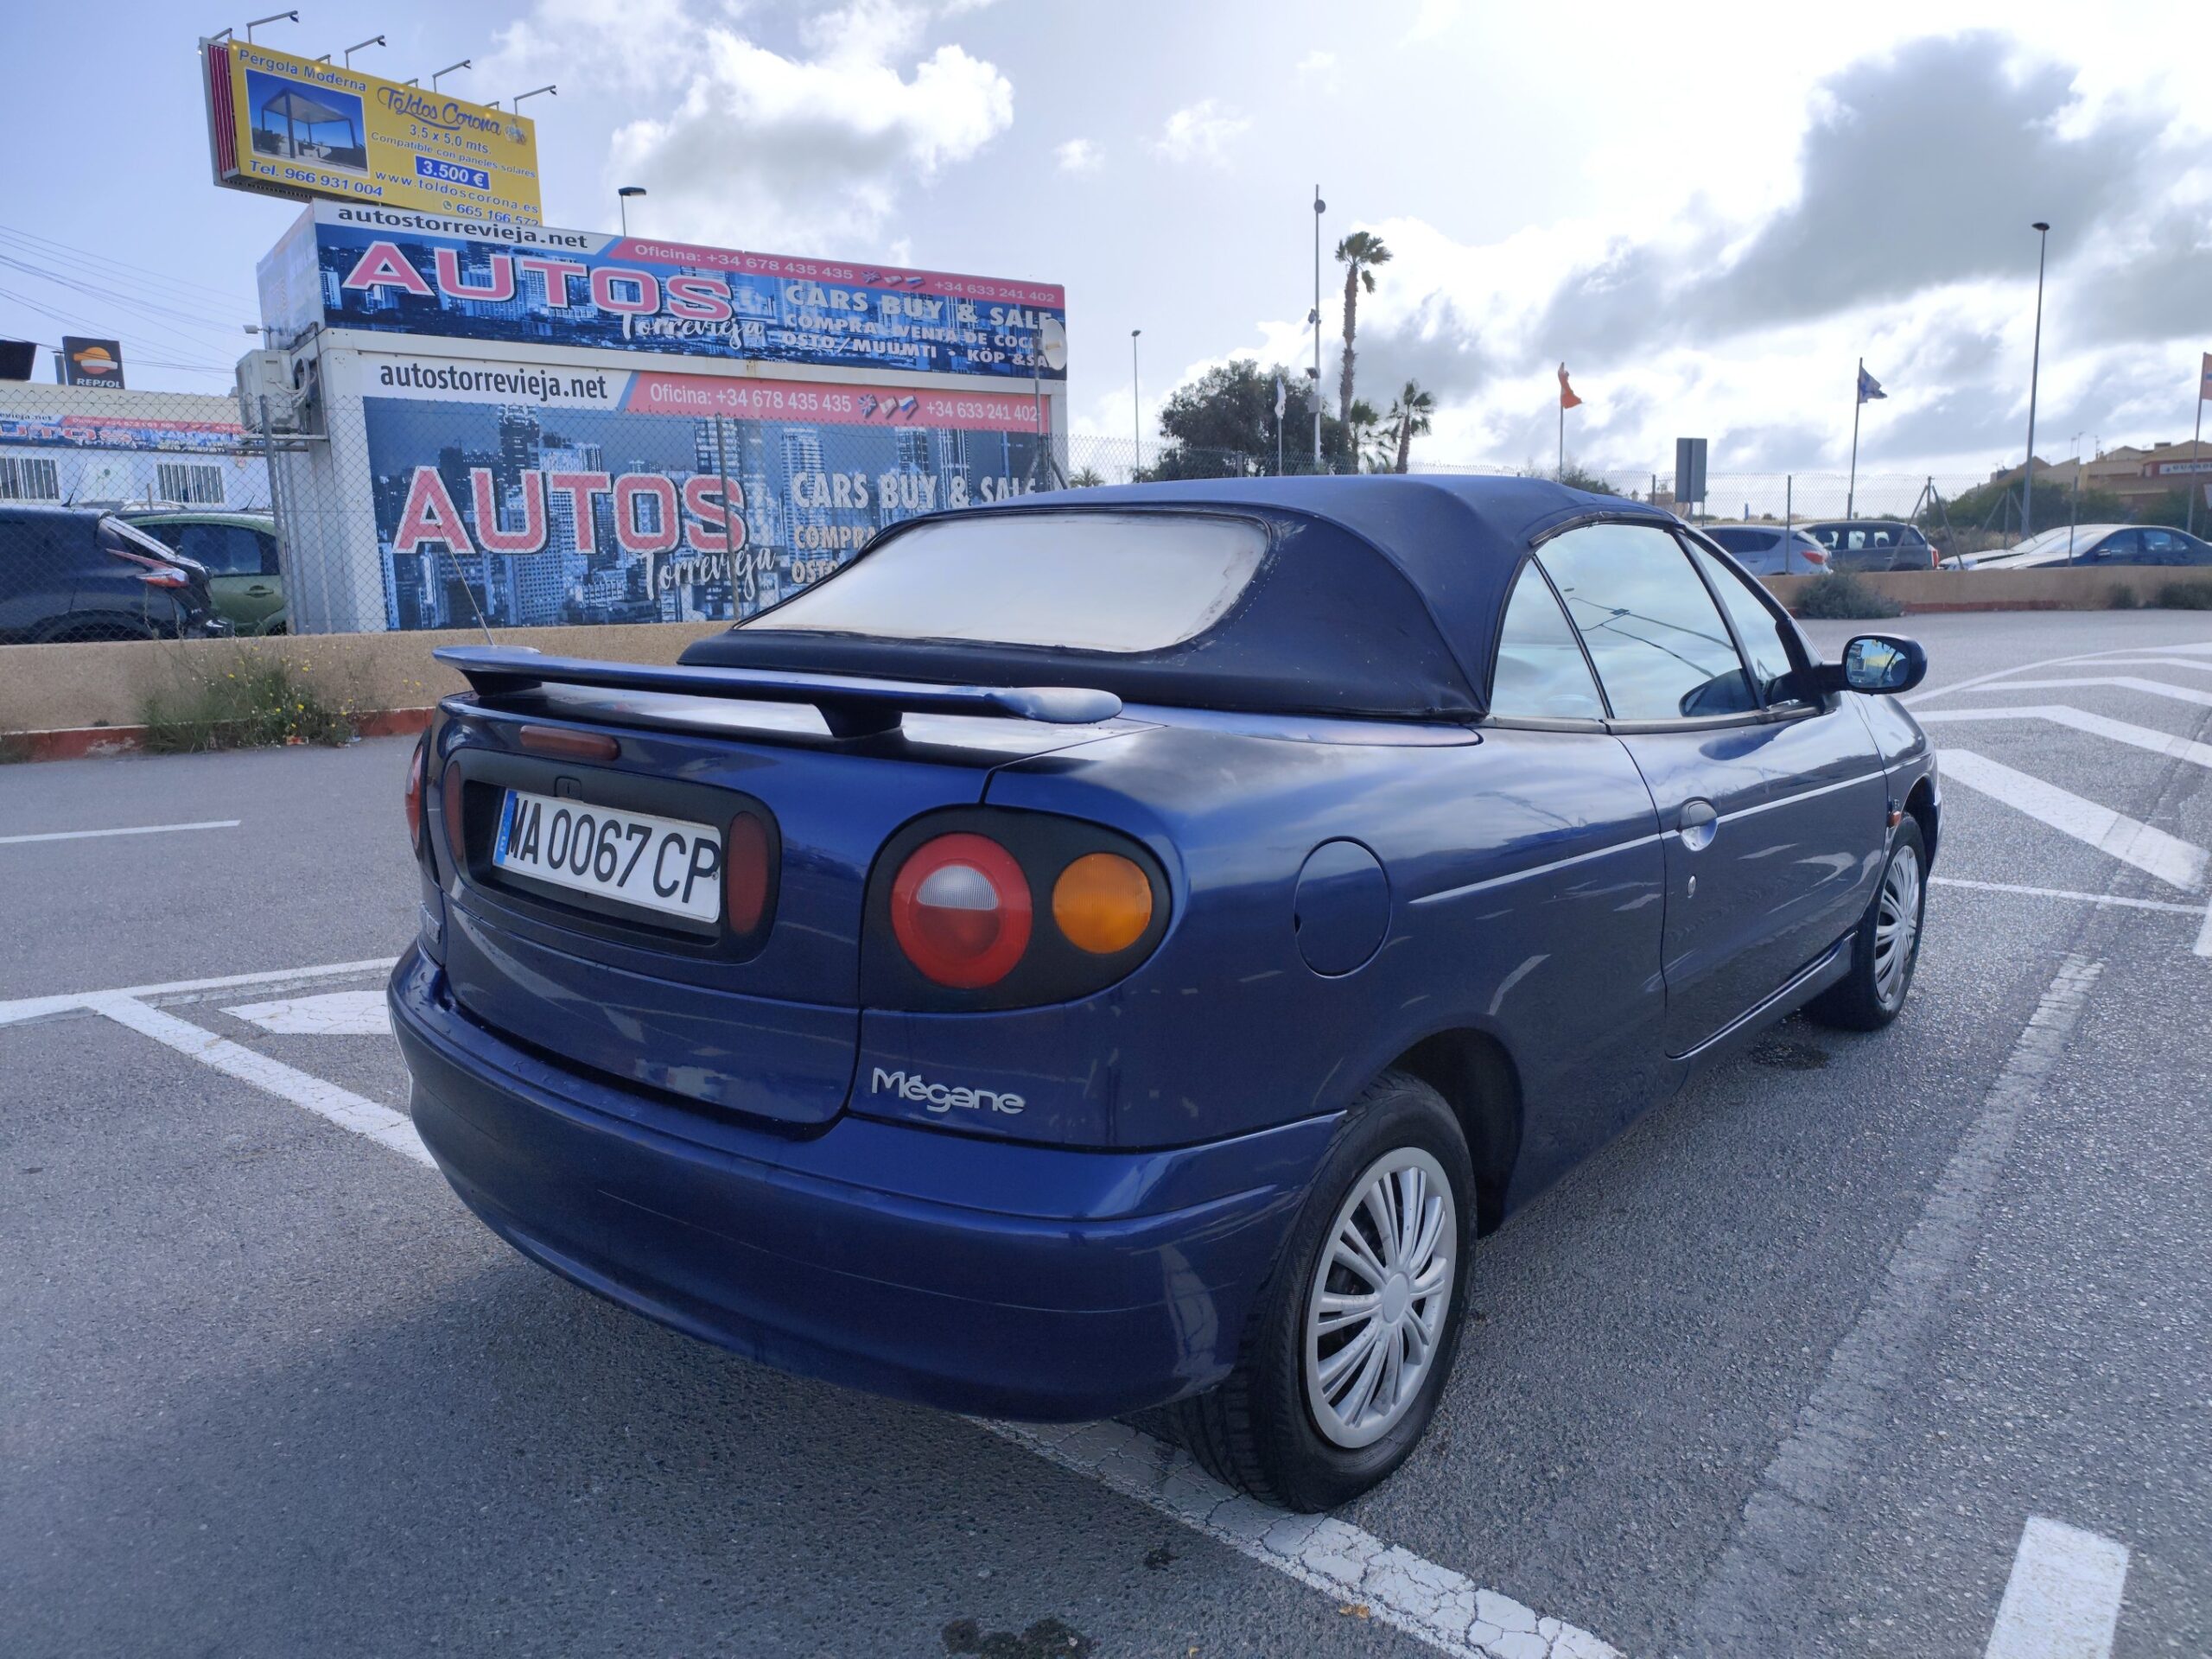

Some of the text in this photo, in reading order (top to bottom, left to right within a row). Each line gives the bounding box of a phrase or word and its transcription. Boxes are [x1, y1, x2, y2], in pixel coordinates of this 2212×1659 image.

[304, 66, 366, 92] Moderna
[378, 87, 501, 136] Toldos Corona
[372, 131, 536, 178] Compatible con paneles solares
[410, 124, 429, 139] 3,5
[433, 132, 439, 141] x
[444, 133, 461, 148] 5,0
[250, 160, 383, 197] Tel. 966 931 004
[423, 160, 484, 188] 3.500 €
[338, 207, 588, 249] autostorrevieja.net
[456, 204, 482, 217] 665
[488, 210, 511, 223] 166
[342, 241, 733, 321] AUTOS
[635, 245, 1055, 302] Oficina: +34 678 435 435 +34 633 241 402
[785, 285, 868, 312] CARS
[881, 295, 944, 320] BUY
[957, 303, 978, 324] &
[620, 311, 766, 349] Torrevieja
[964, 332, 988, 345] DE
[968, 347, 1005, 364] KÖP
[77, 378, 121, 388] REPSOL
[380, 363, 608, 402] autostorrevieja.net
[651, 383, 1038, 422] Oficina: +34 678 435 435 +34 633 241 402
[393, 466, 746, 554] AUTOS
[791, 472, 869, 509] CARS
[880, 474, 938, 510] BUY
[950, 475, 969, 509] &
[639, 544, 776, 601] Torrevieja
[547, 809, 652, 887] 0067
[653, 832, 721, 903] CP
[872, 1067, 1026, 1114] Mégane
